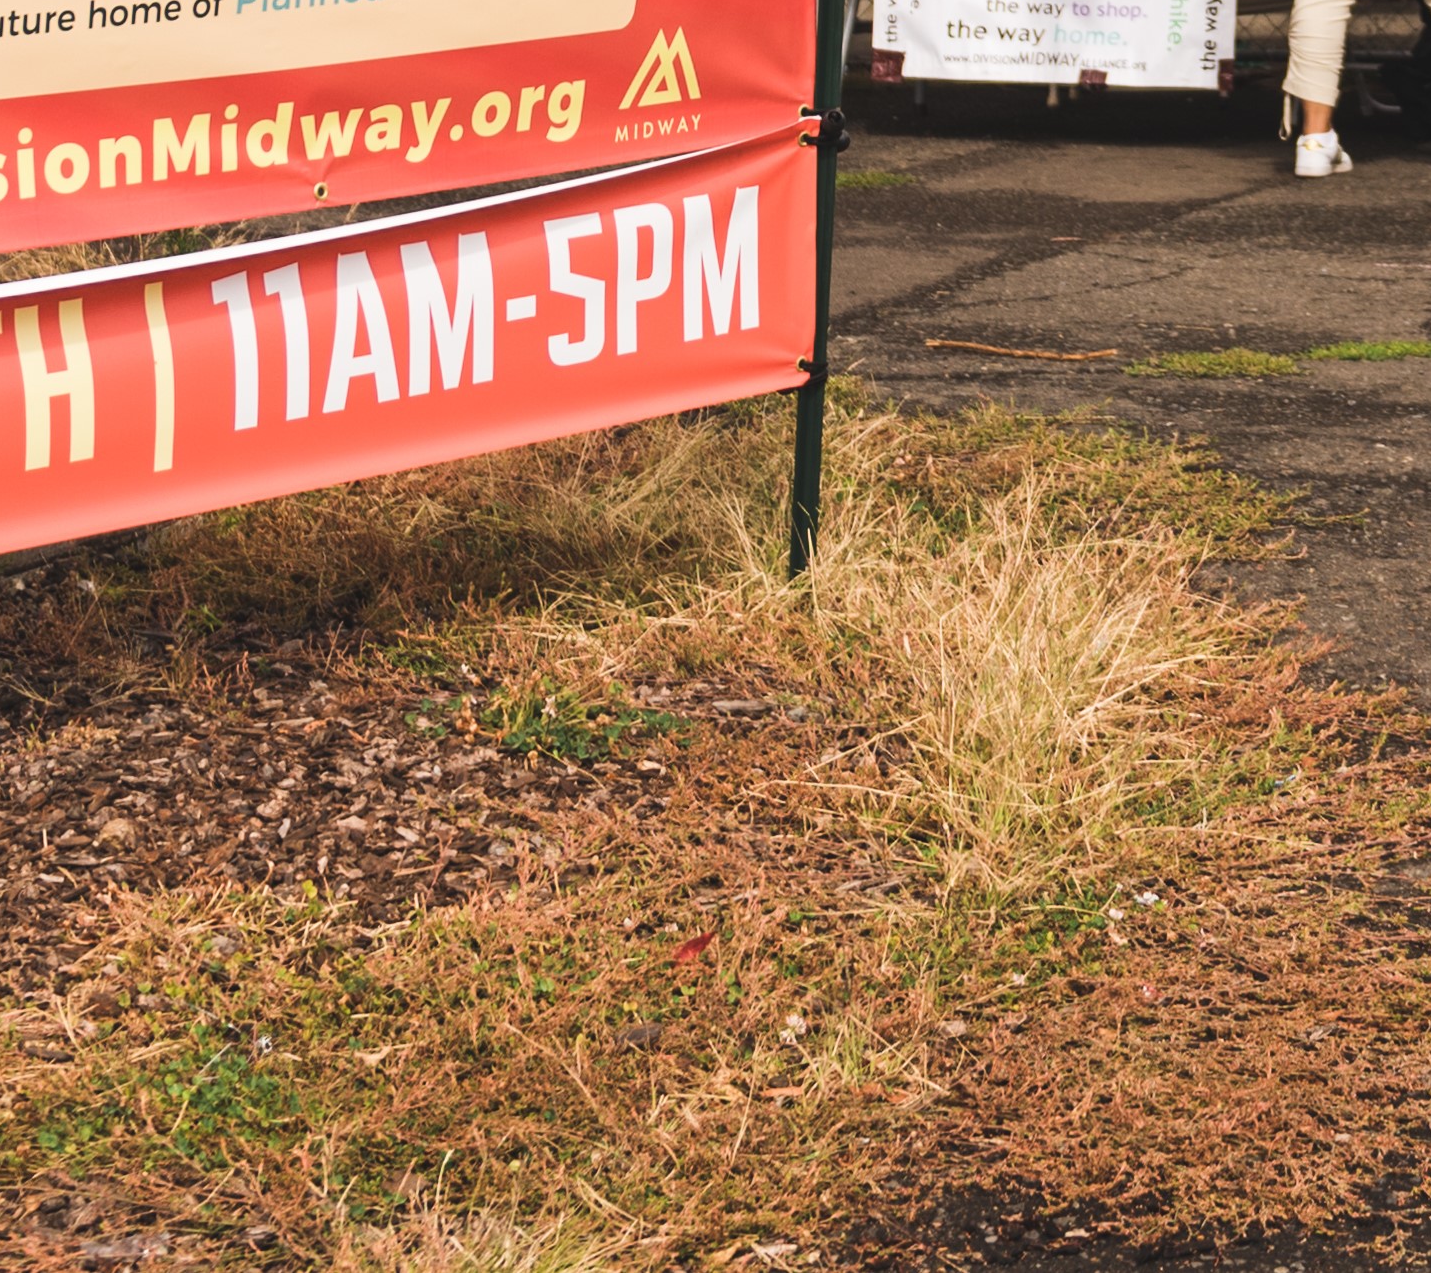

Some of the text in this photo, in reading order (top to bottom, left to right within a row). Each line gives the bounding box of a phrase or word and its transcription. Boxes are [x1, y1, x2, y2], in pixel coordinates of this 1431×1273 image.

[1027, 3, 1064, 18] way
[1072, 3, 1090, 17] to
[1097, 1, 1148, 21] shop.
[886, 13, 898, 43] the
[947, 19, 1128, 46] the way home.
[1200, 39, 1217, 70] the
[613, 113, 703, 144] MIDWAY
[208, 181, 765, 434] 11AM-5PM
